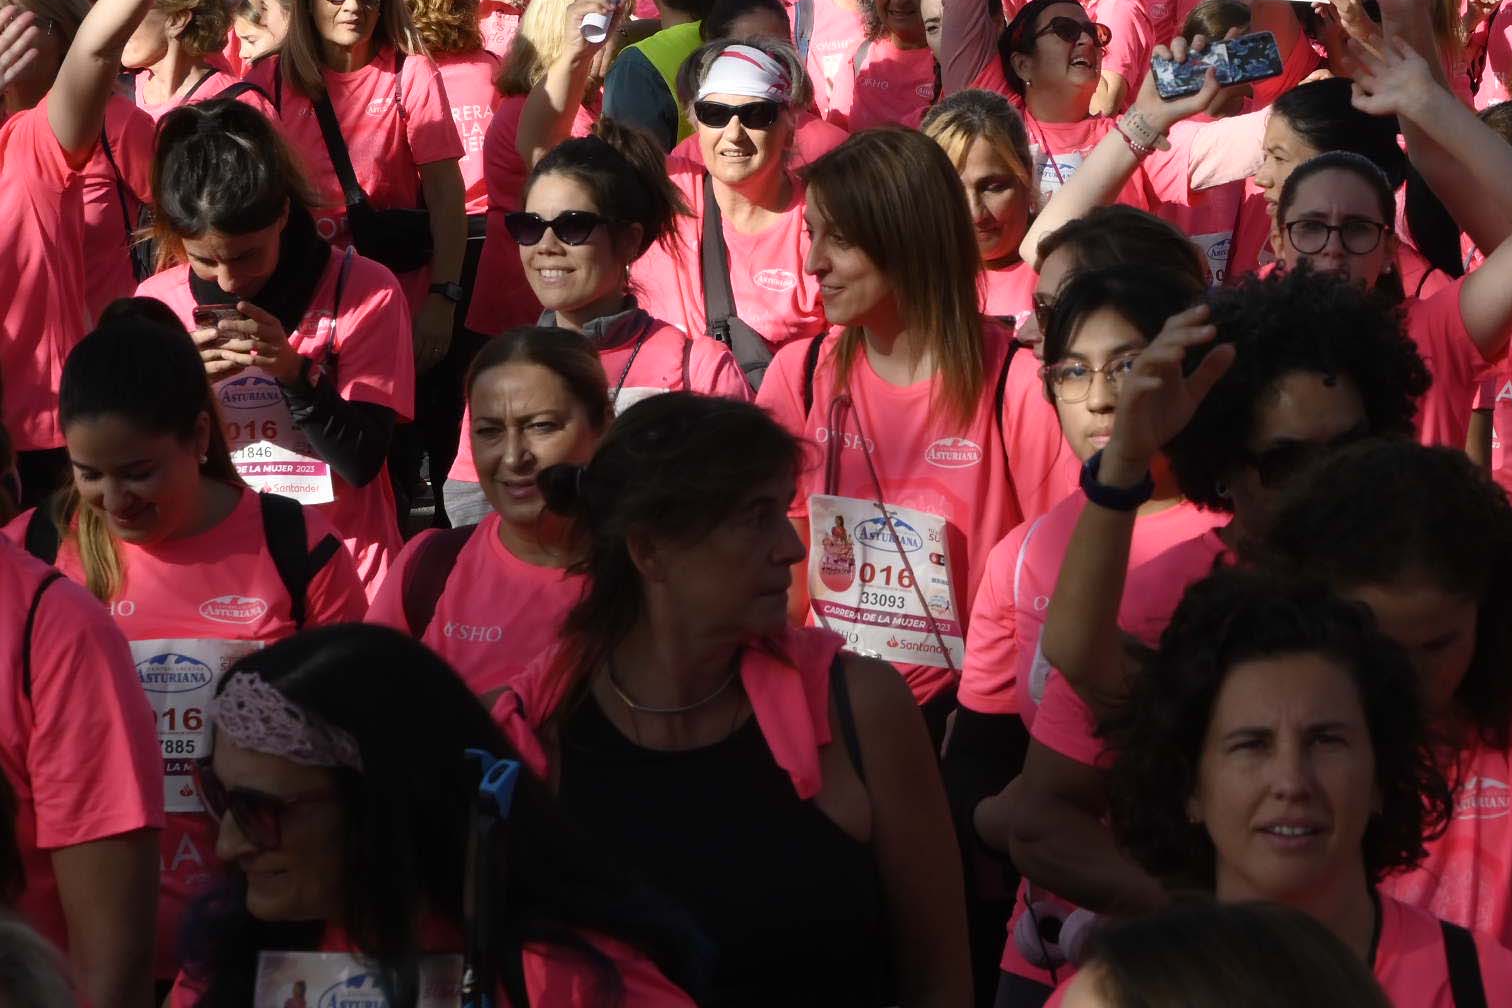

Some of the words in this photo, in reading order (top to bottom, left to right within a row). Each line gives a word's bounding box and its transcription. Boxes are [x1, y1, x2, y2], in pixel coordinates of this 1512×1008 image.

[461, 122, 483, 137] LA
[222, 390, 279, 403] ASTURIANA
[225, 420, 277, 440] 016
[927, 448, 978, 461] ASTURIANA
[296, 465, 316, 473] 2023
[273, 483, 320, 493] Santander
[859, 562, 914, 589] 016
[860, 591, 906, 609] 33093
[203, 600, 264, 618] ASTURIANA
[823, 604, 862, 621] CARRERA
[863, 612, 877, 623] DE
[877, 614, 890, 624] LA
[892, 615, 927, 630] MUJER
[137, 668, 207, 685] ASTURIANA
